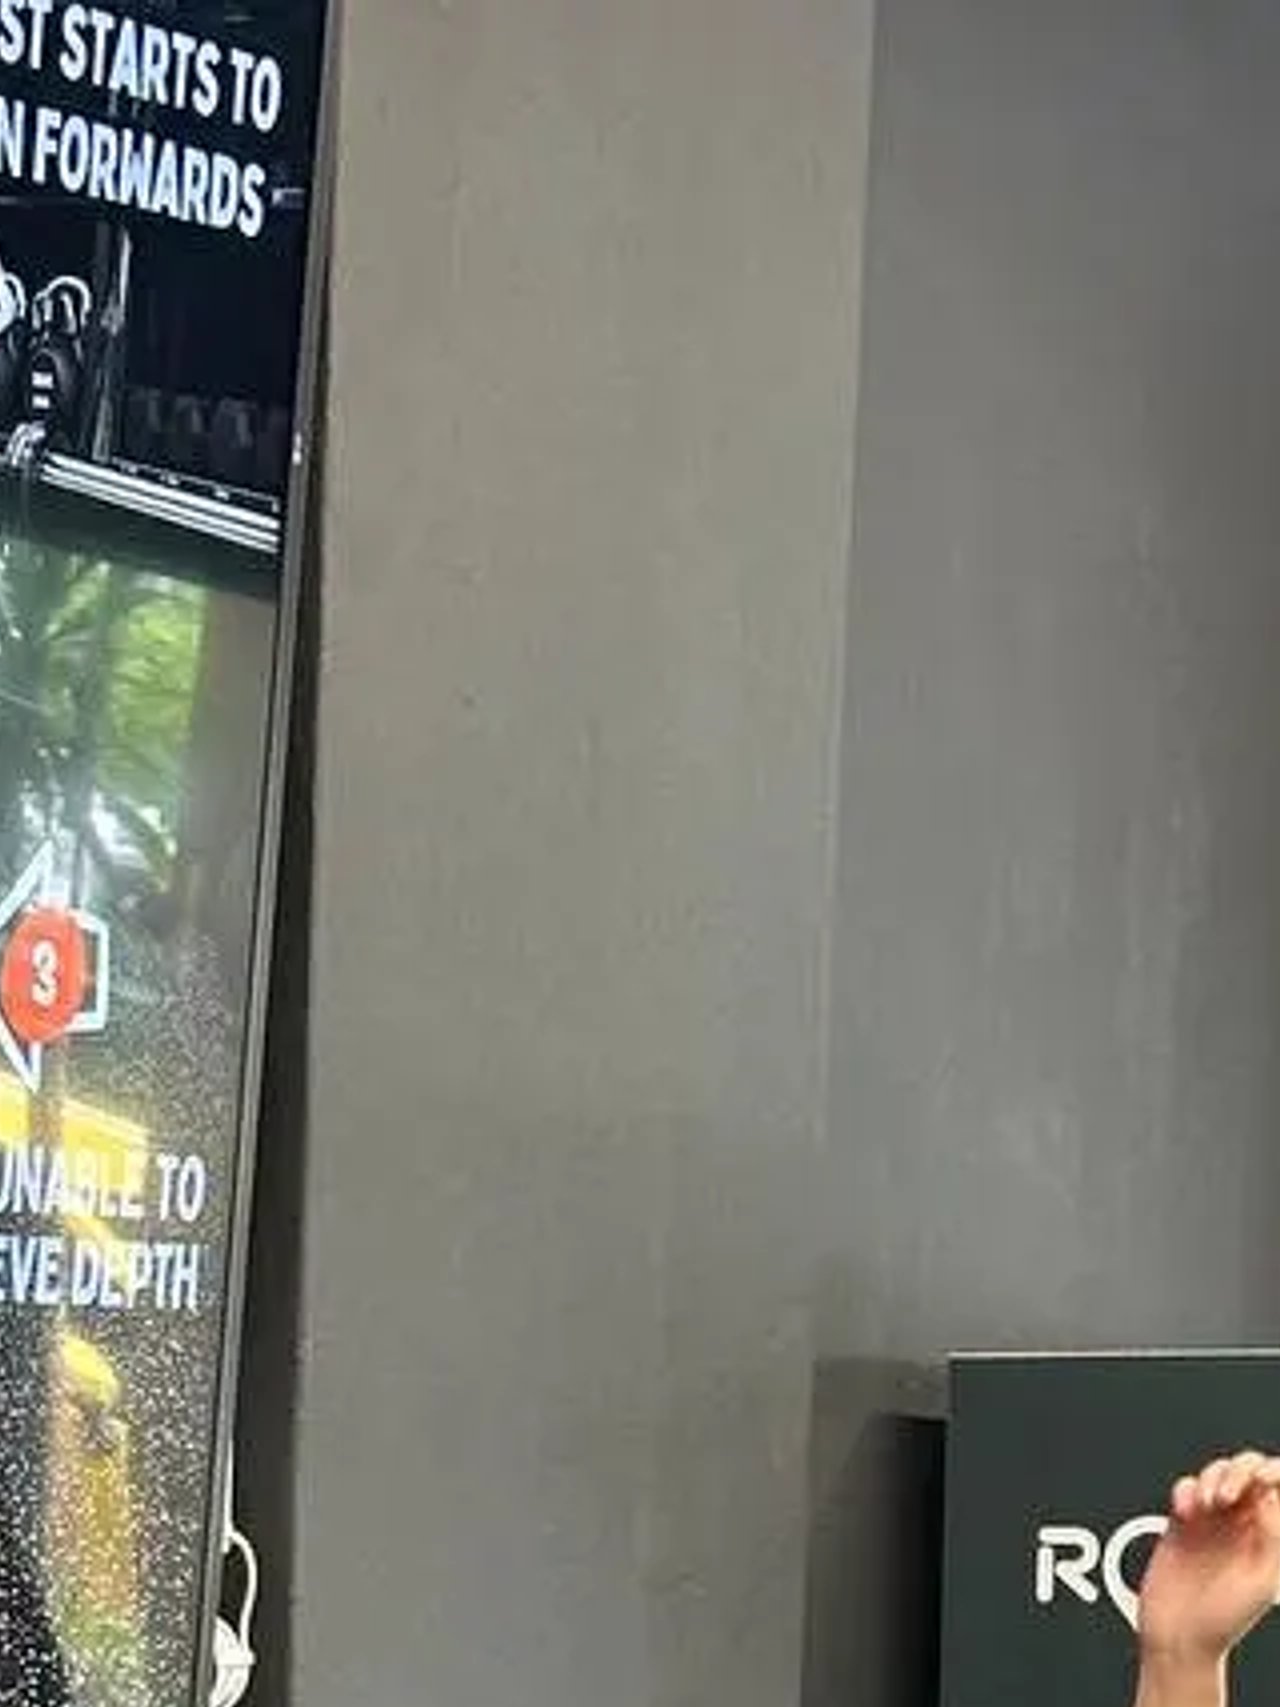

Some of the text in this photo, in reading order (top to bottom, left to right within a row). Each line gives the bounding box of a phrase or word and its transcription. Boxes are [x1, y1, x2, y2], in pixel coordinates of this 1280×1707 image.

[58, 5, 222, 120] STARTS
[228, 54, 282, 132] TO
[30, 105, 267, 238] FORWARDS
[30, 940, 59, 1007] 3
[156, 1154, 206, 1222] TO
[71, 1240, 200, 1310] DEPTH
